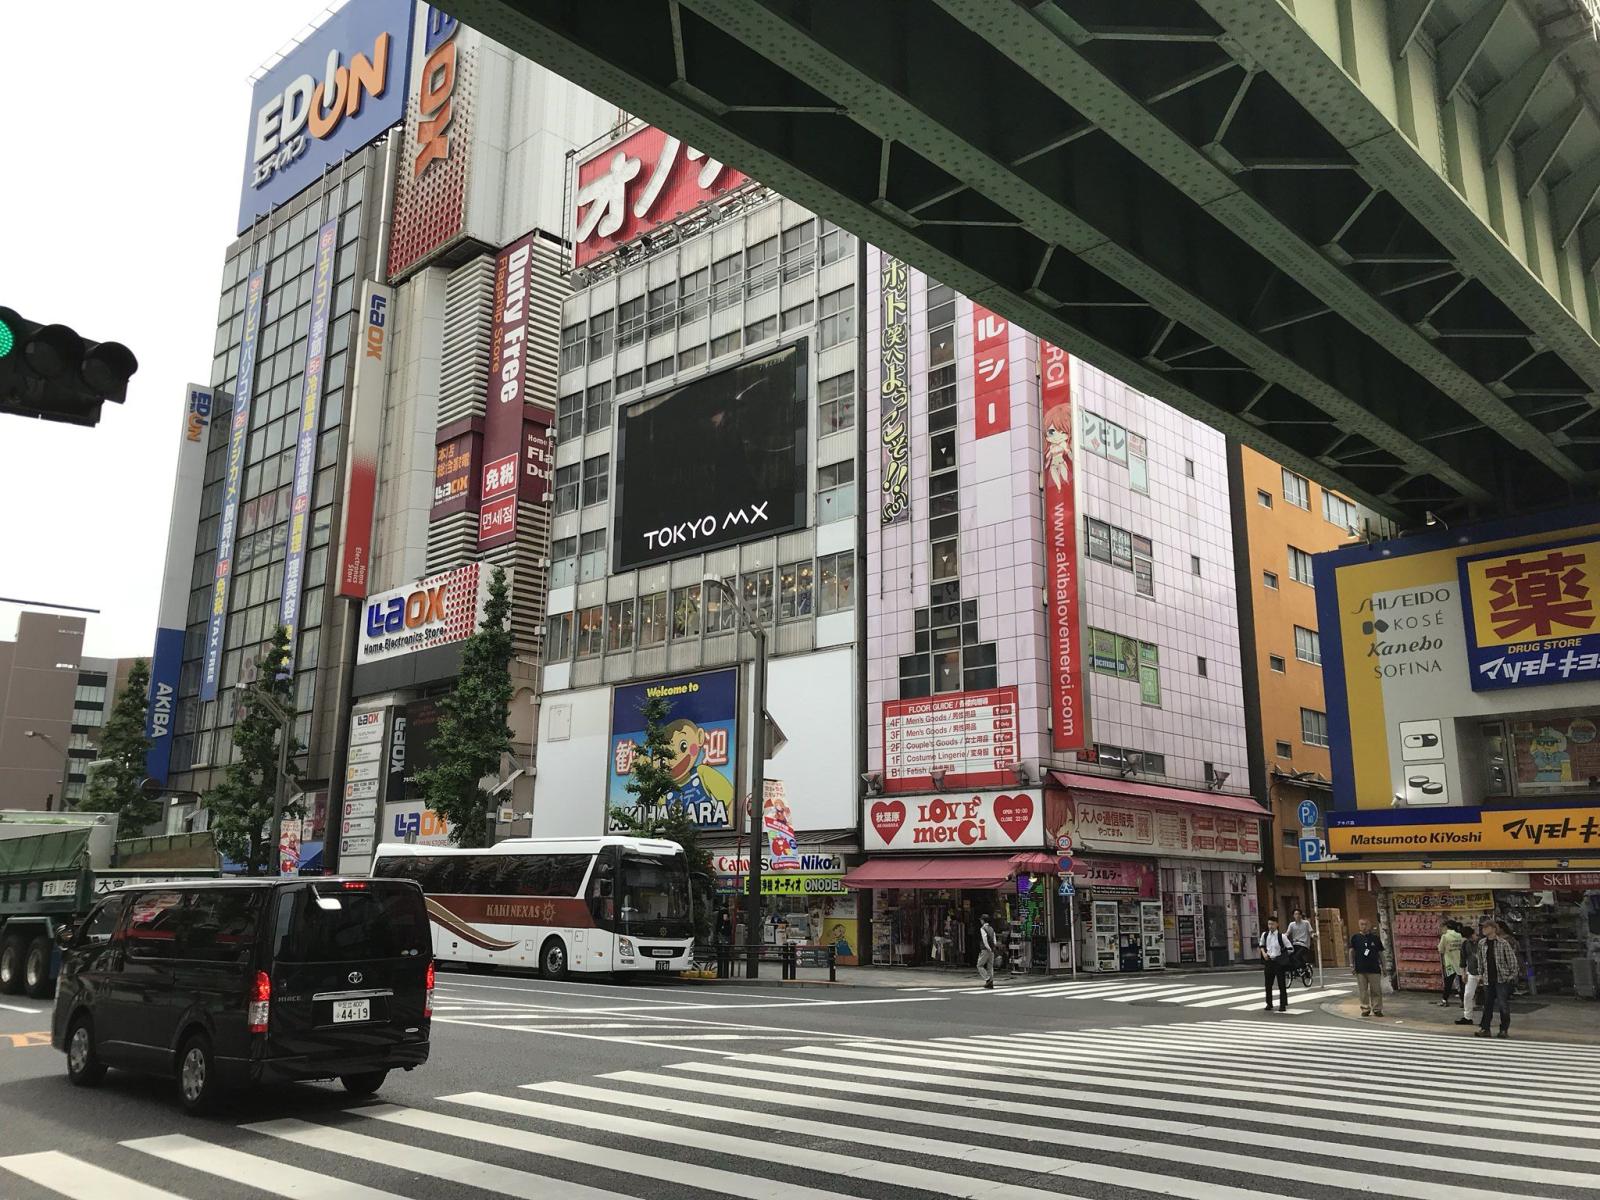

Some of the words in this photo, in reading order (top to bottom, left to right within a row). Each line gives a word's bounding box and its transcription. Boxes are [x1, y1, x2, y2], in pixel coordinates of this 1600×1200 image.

[253, 32, 389, 163] EDION
[250, 134, 306, 189] エディオン
[495, 256, 508, 323] Flagship
[503, 243, 530, 324] Duty
[492, 327, 503, 373] Store
[501, 325, 525, 404] Free
[187, 392, 212, 443] EDION
[486, 461, 515, 492] 免税
[482, 504, 513, 531] 면세점
[643, 515, 717, 550] TOKYO
[722, 501, 768, 530] MX
[353, 547, 362, 584] Electronics
[1352, 588, 1450, 615] SHISEIDO
[1485, 551, 1596, 640] 薬
[1053, 502, 1075, 736] www.akibalovemerci.com
[1394, 610, 1444, 630] KOSÉ
[209, 618, 220, 647] TAX
[364, 643, 383, 655] Home
[385, 632, 423, 651] Electronics
[425, 627, 444, 638] Store
[1367, 635, 1443, 658] Kanebo
[1508, 643, 1540, 654] DRUG
[1544, 638, 1582, 650] STORE
[1374, 659, 1442, 679] SOFINA
[1480, 650, 1600, 683] マツモトキヨ
[647, 684, 688, 698] Welcome
[688, 682, 699, 692] to
[151, 682, 173, 737] AKIBA
[890, 719, 900, 727] 4F
[925, 713, 947, 723] Goods
[909, 705, 930, 713] FLOOR
[933, 702, 953, 710] GUIDE
[890, 731, 900, 739] 3F
[906, 729, 924, 737] Men's
[925, 726, 948, 735] Goods
[890, 744, 900, 752] 2F
[906, 740, 935, 750] Couple's
[936, 738, 958, 747] Goods
[891, 756, 900, 764] 1F
[906, 754, 936, 763] Costume
[938, 750, 966, 760] Lingerie
[891, 769, 900, 777] B1
[906, 767, 927, 775] Fetish
[876, 811, 900, 823] 秋葉原
[918, 797, 979, 823] LOVE
[1080, 808, 1134, 828] 大人の通信販売
[1060, 839, 1069, 847] 20
[1350, 834, 1427, 846] Matsumoto
[1430, 832, 1481, 843] KiYoshi
[1503, 816, 1600, 844] マツモトキ
[1305, 841, 1316, 862] P
[775, 878, 801, 892] オーディオ
[341, 1008, 368, 1020] 44-19
